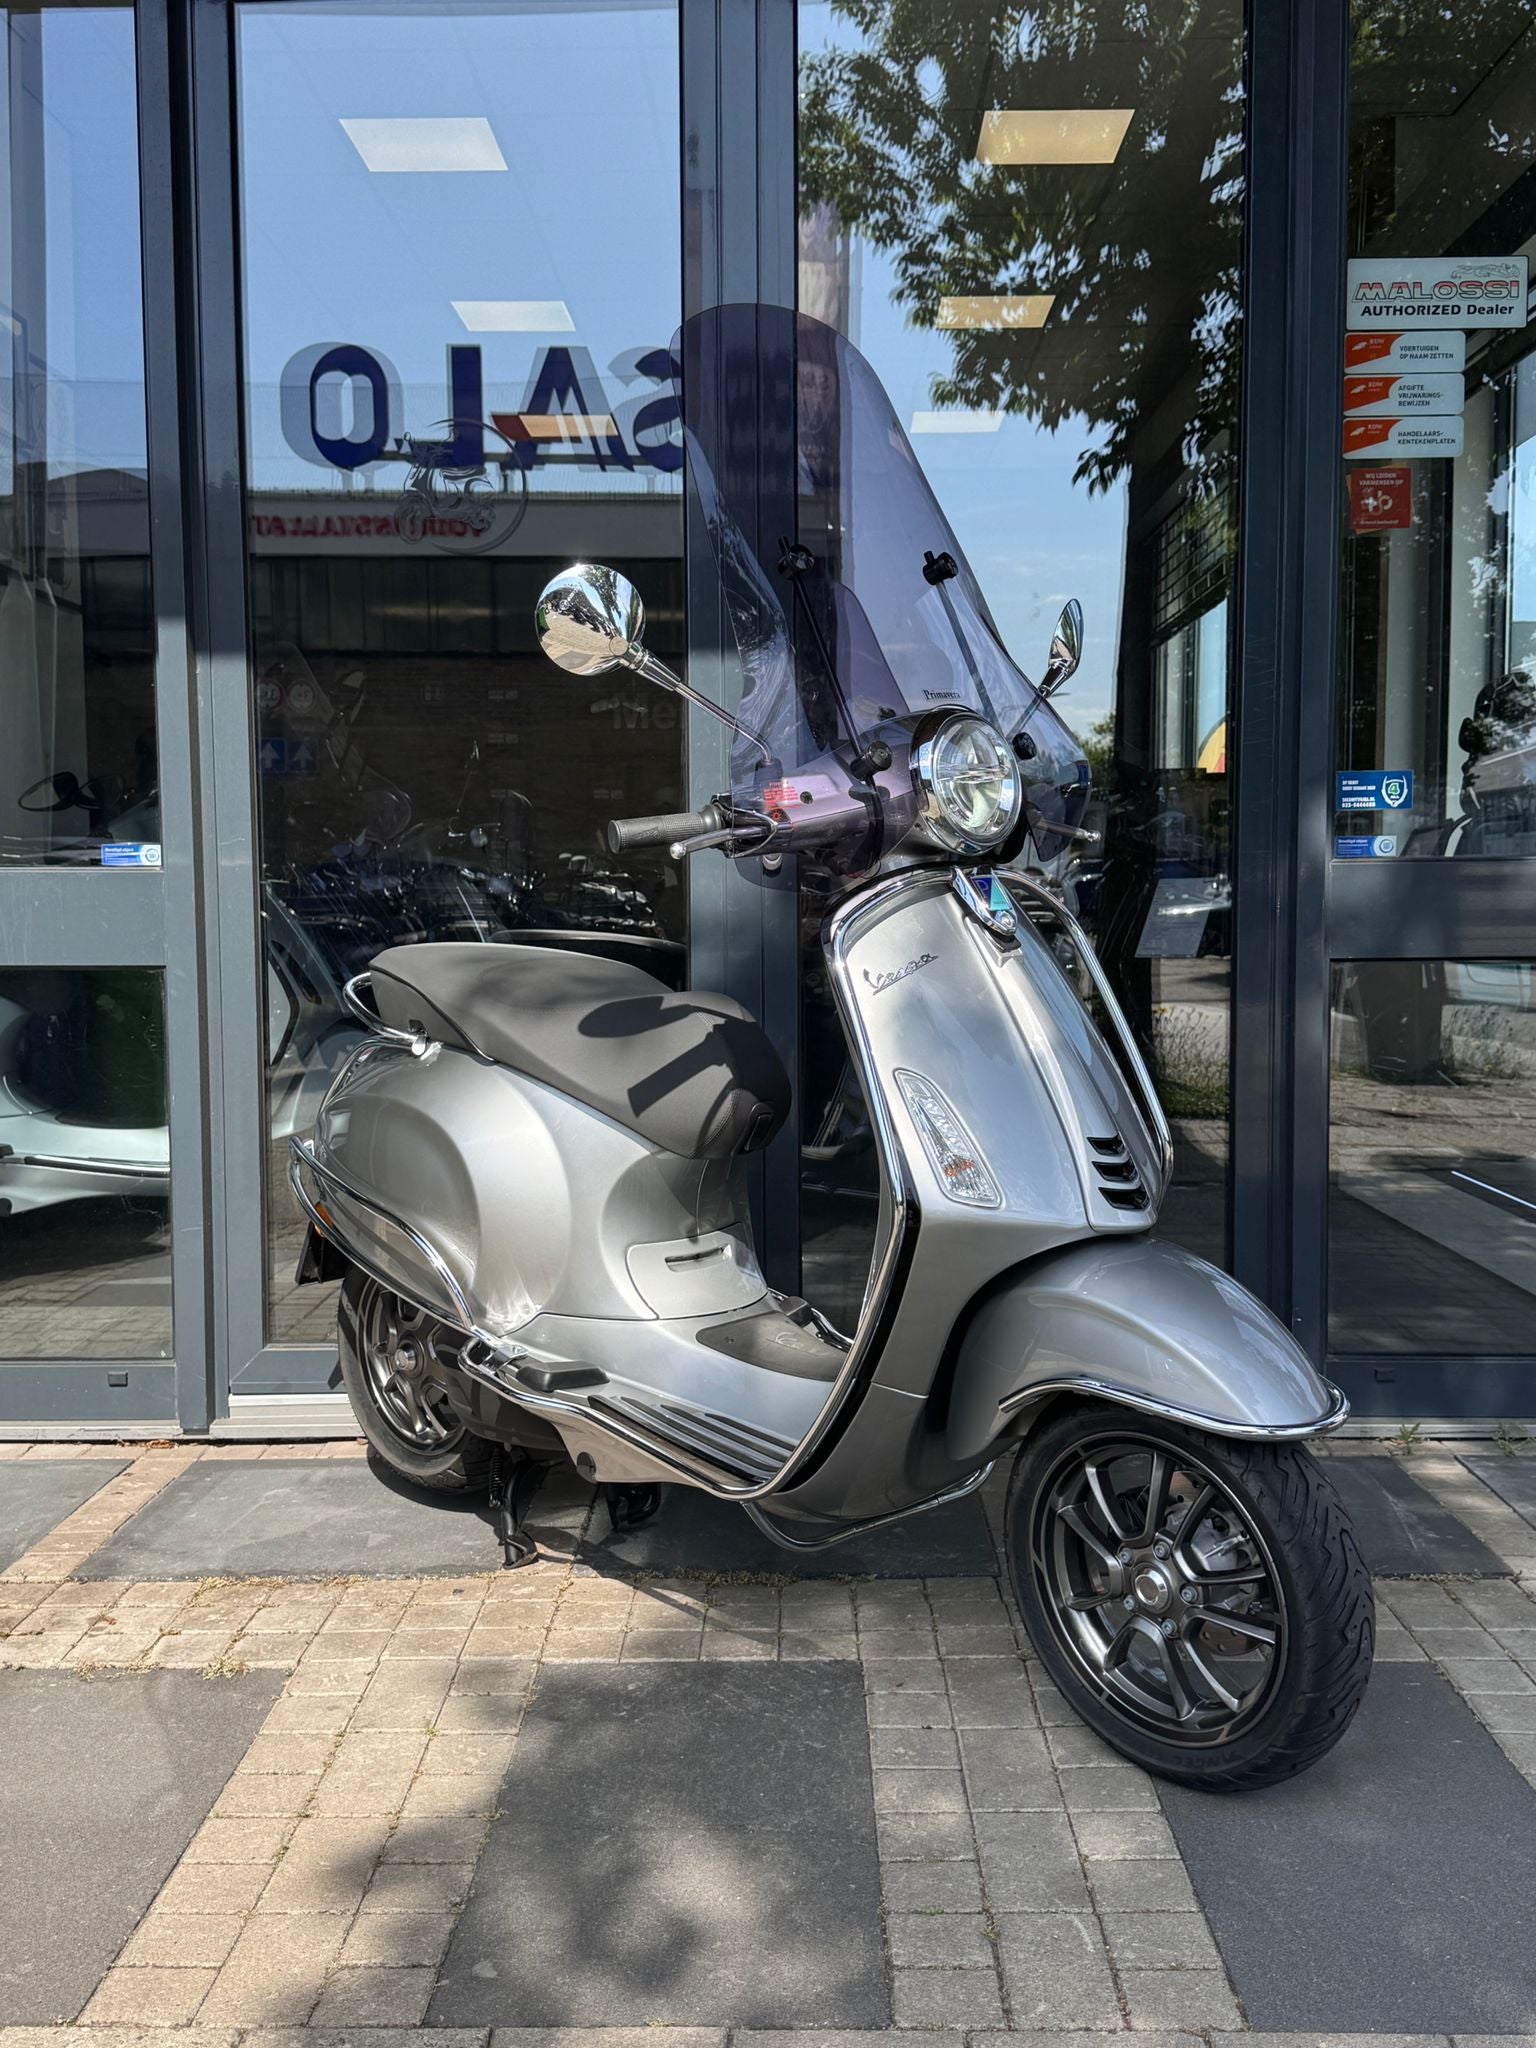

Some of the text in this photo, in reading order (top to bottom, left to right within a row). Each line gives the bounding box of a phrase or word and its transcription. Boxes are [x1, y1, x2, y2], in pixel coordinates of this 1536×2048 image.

[1352, 280, 1520, 303] MALOSSI
[1361, 303, 1515, 317] AUTHORIZED Dealer
[922, 689, 961, 700] Primavera
[862, 951, 940, 996] Vespa
